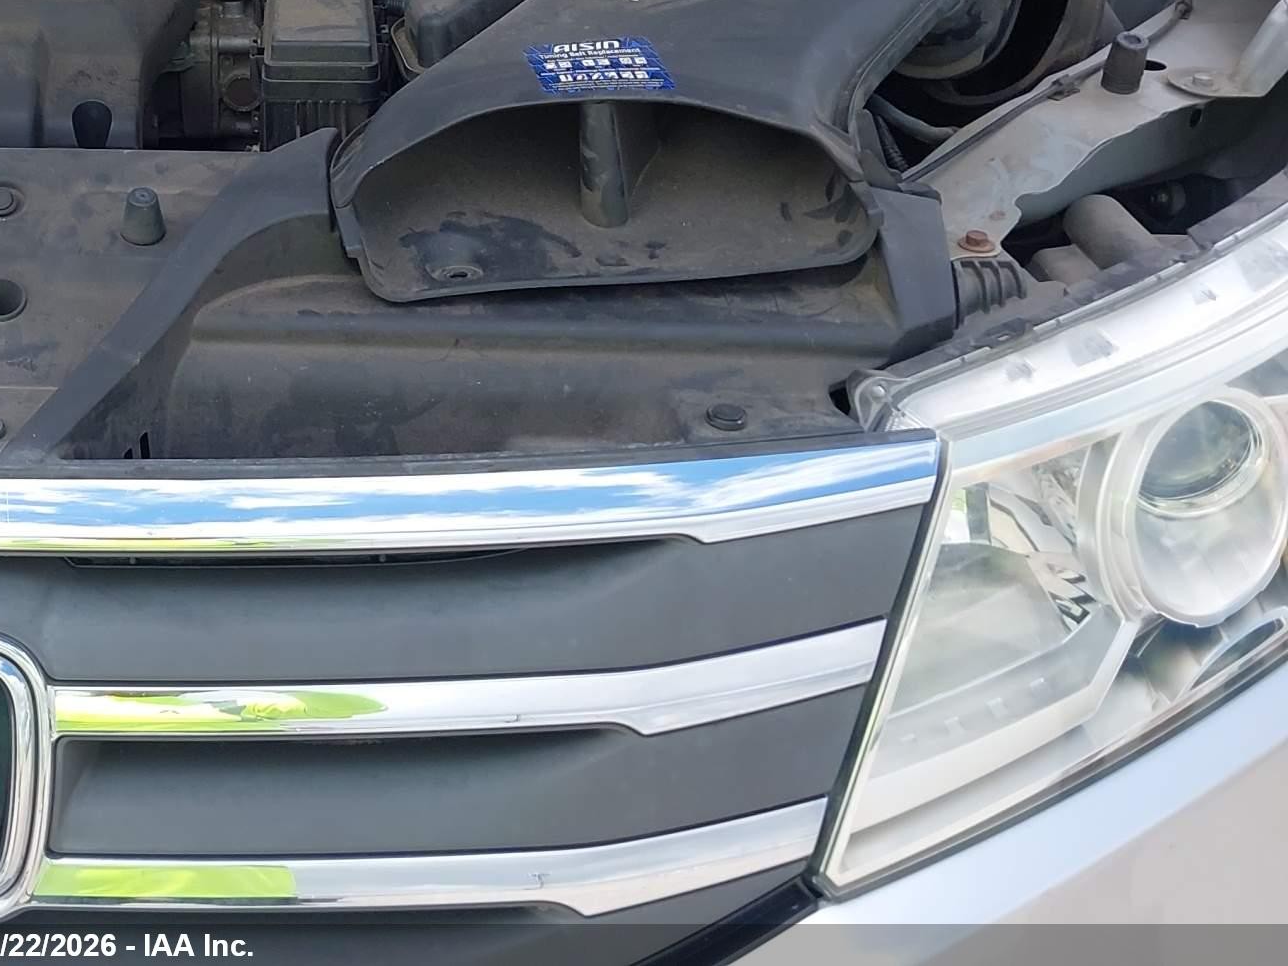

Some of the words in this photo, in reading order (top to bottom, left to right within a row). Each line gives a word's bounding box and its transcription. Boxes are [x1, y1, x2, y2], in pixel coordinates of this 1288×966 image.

[539, 52, 569, 60] Timing
[569, 49, 586, 57] Belt
[587, 47, 642, 56] Replacement
[553, 40, 620, 54] AISIN
